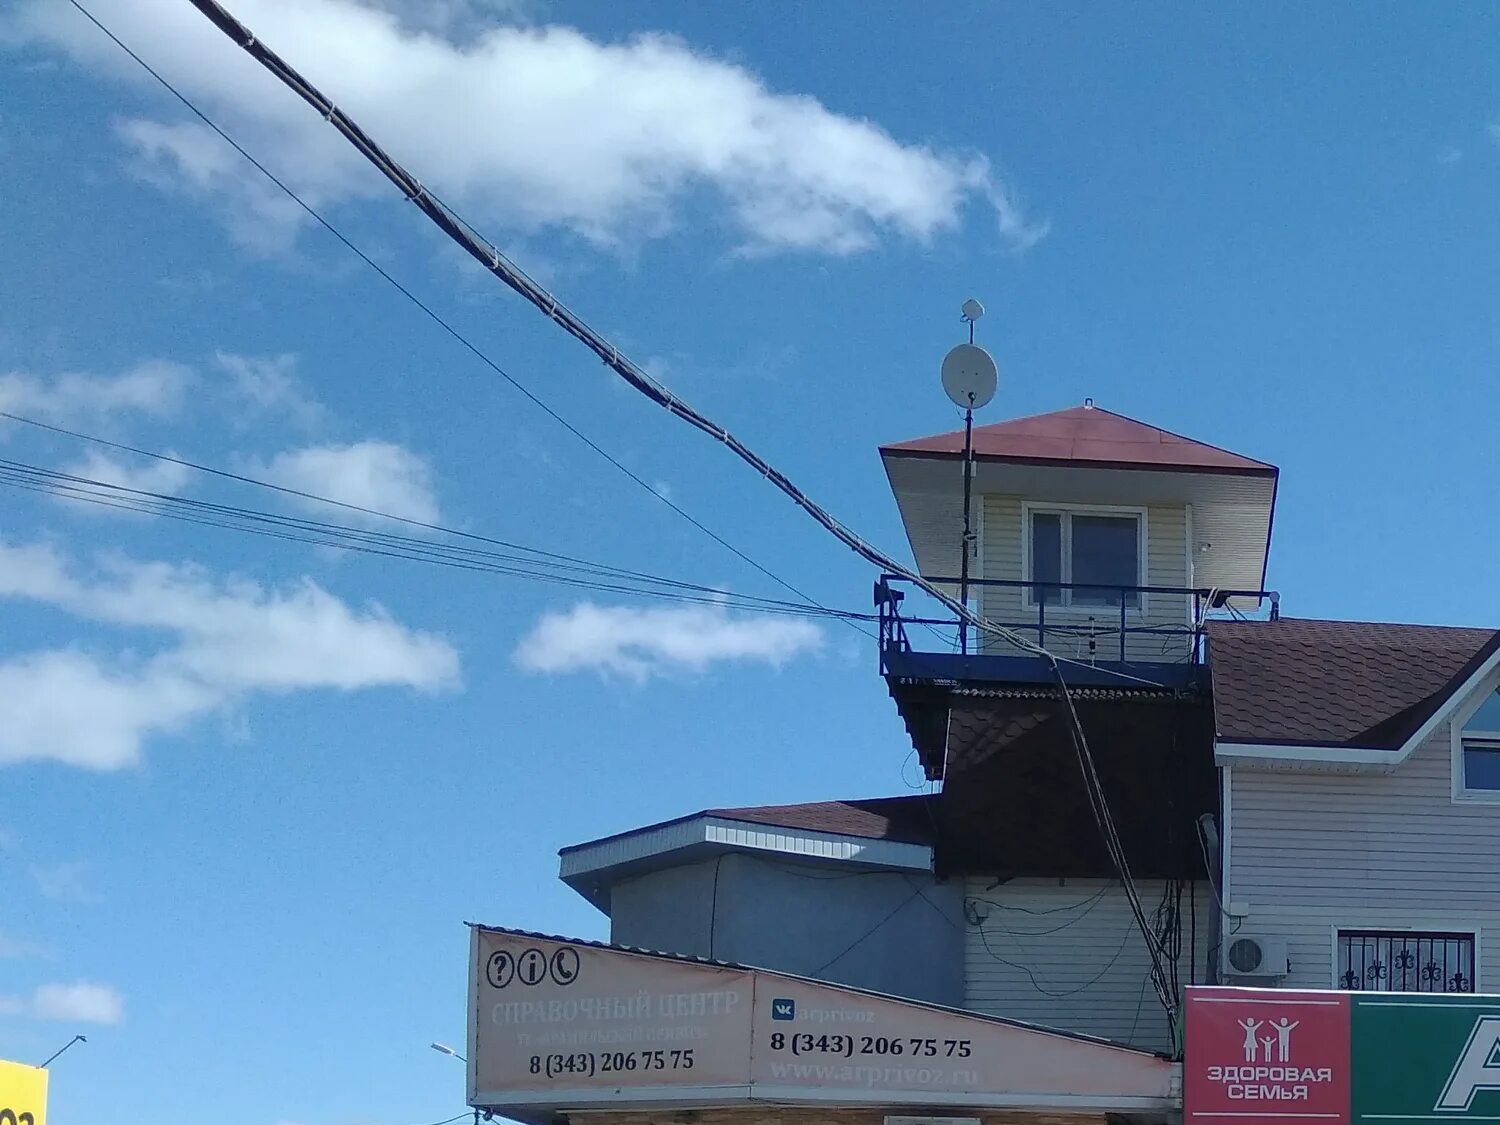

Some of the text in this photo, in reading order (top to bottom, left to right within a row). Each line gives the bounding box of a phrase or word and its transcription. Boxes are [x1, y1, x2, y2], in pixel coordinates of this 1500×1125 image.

[491, 988, 740, 1025] СПРАВОЧНЫЙ ЦЕНТР
[801, 1008, 875, 1023] arprivoz
[770, 1032, 972, 1058] 8 (343) 206 75 75
[529, 1049, 694, 1078] 8 (343) 206 75 75
[770, 1061, 979, 1087] www.arprivoz.ru
[1207, 1066, 1332, 1083] ЗДОРОВАЯ
